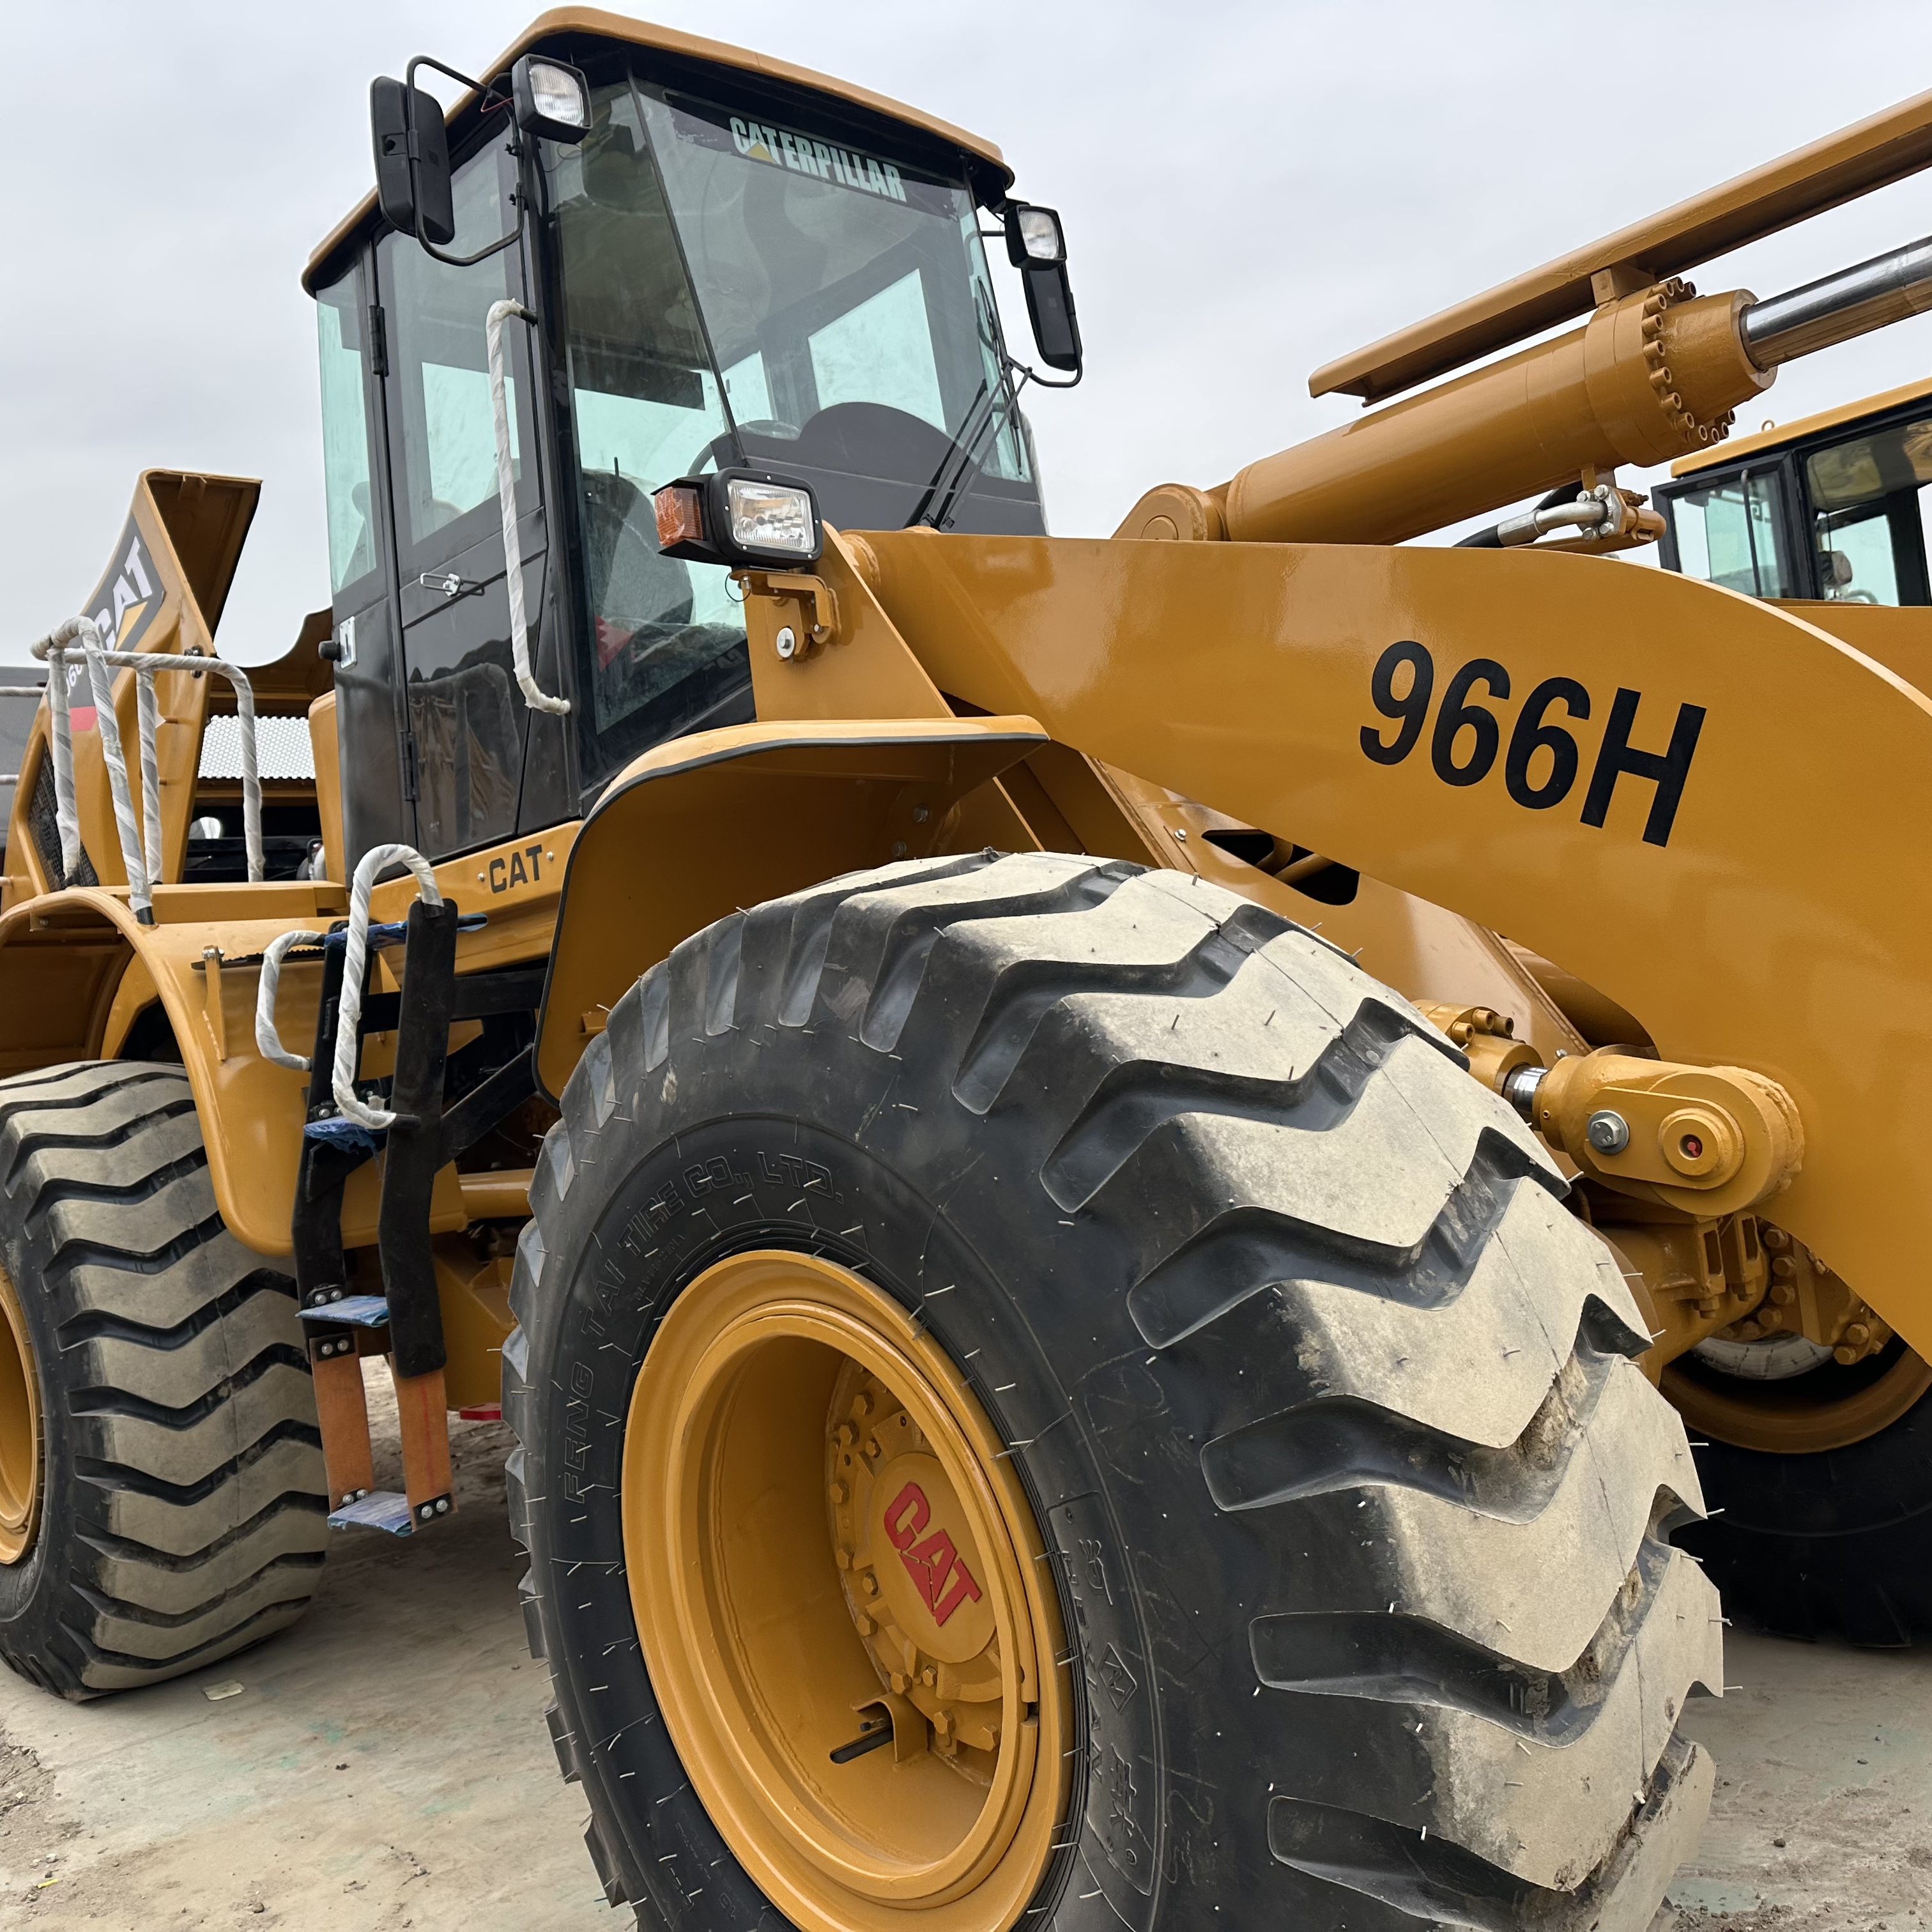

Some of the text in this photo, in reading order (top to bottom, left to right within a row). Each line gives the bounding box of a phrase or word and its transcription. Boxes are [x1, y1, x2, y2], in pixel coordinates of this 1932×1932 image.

[729, 116, 907, 203] CATERPILLAR
[94, 535, 153, 651] CAT
[1359, 640, 1708, 848] 966H
[489, 844, 542, 894] CAT
[564, 1361, 594, 1505] FENG
[581, 1259, 627, 1338] TAI
[617, 1180, 686, 1257] TIRE
[883, 1482, 983, 1628] CAT
